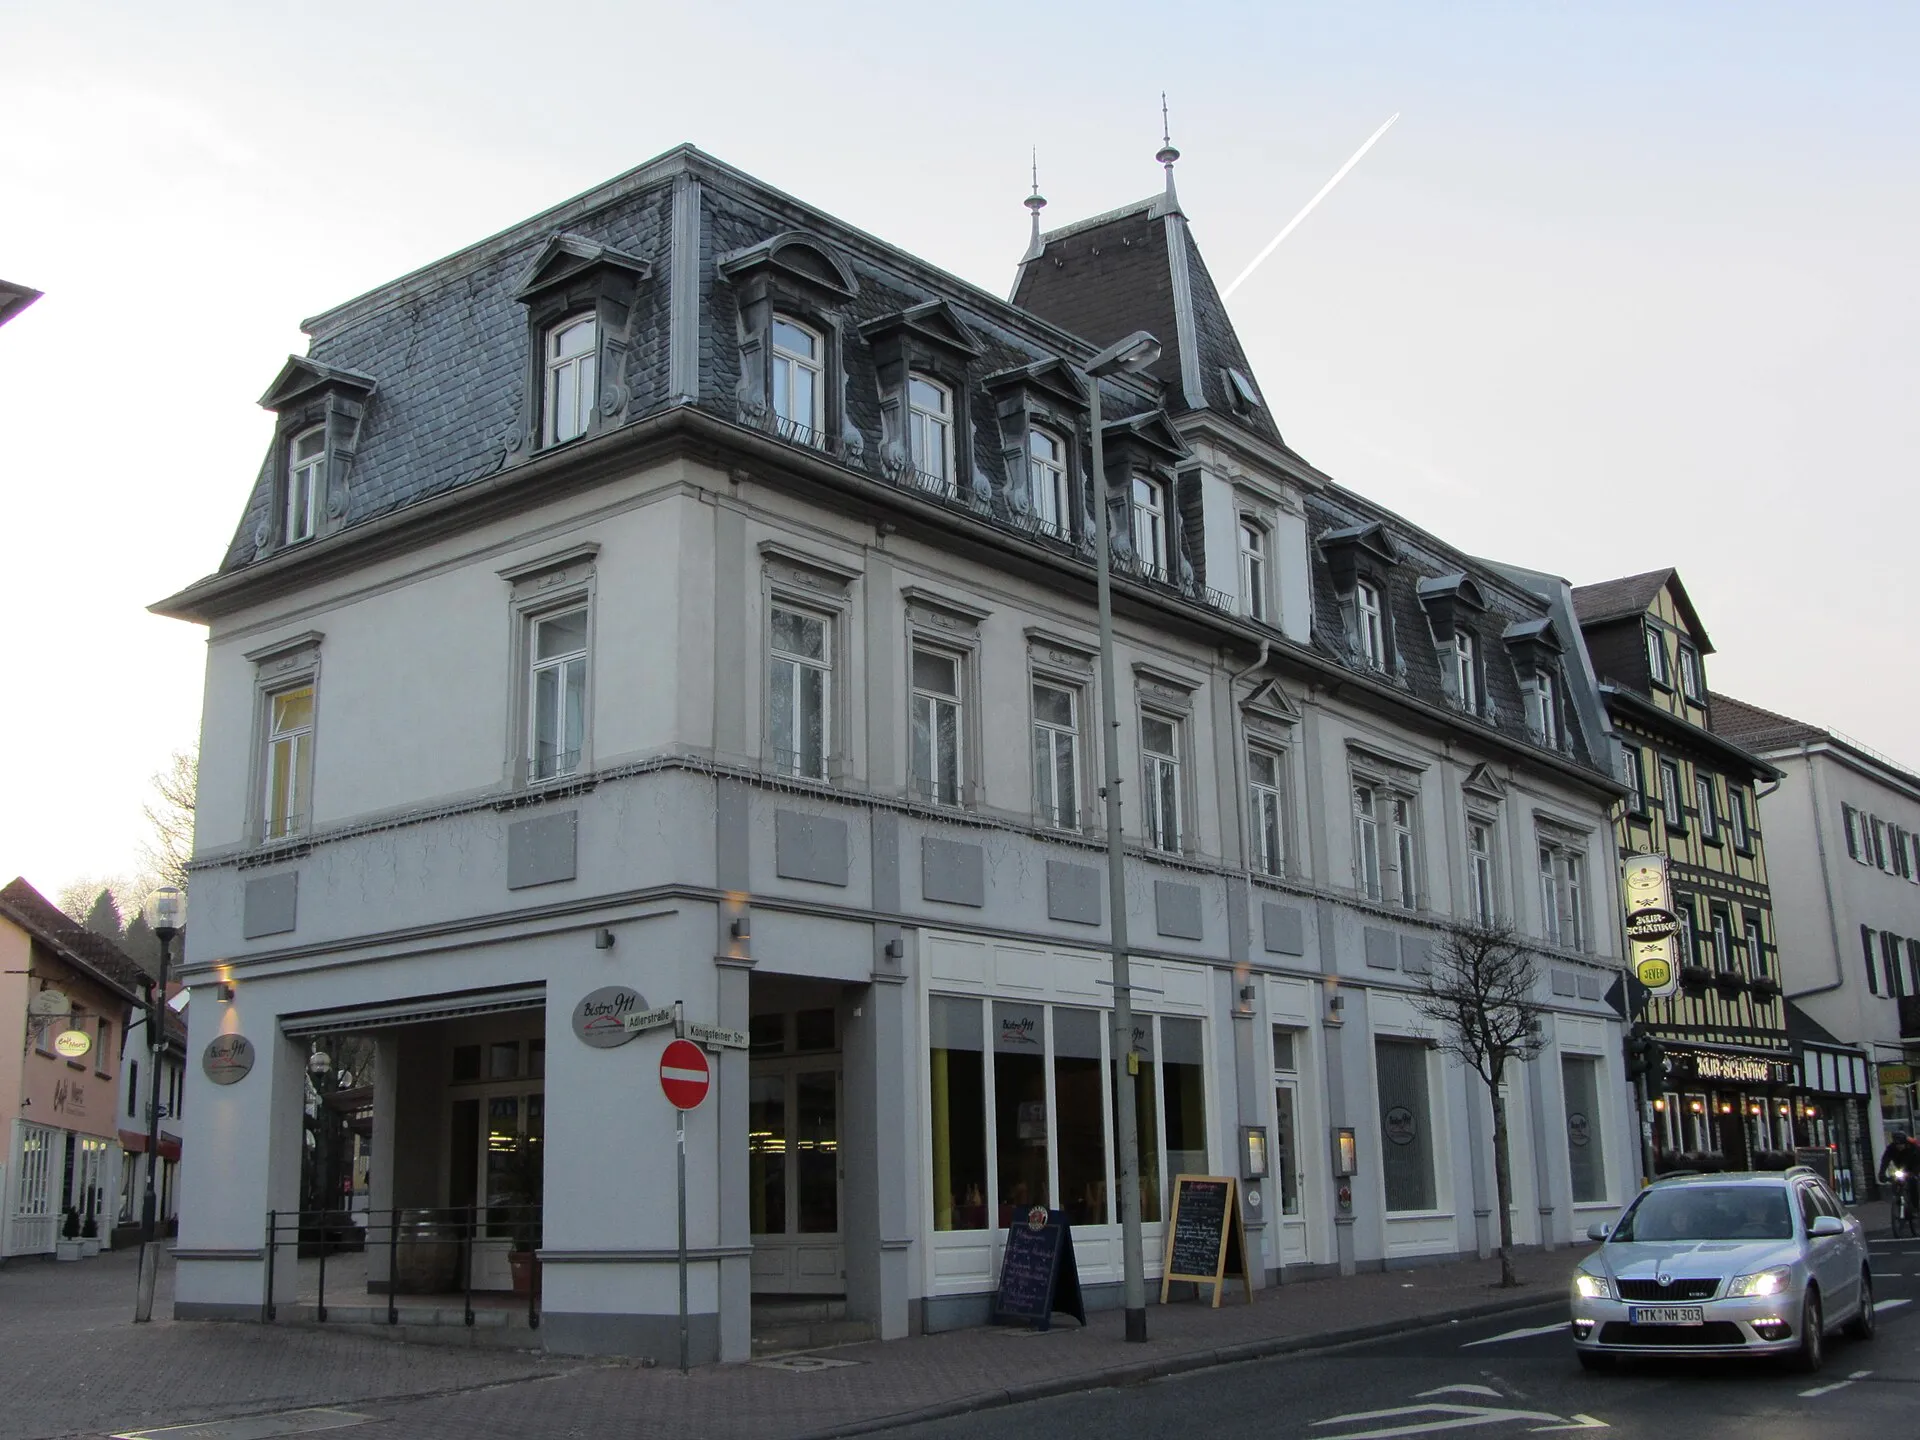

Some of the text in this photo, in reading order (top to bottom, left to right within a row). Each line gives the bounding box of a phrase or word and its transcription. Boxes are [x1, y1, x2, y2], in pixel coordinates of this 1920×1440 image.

[1644, 968, 1665, 980] JEVER
[584, 993, 636, 1017] Bistro 911
[629, 1009, 670, 1028] Adlerstraße
[1021, 1017, 1034, 1031] 911
[690, 1024, 745, 1044] Königsteiner Str.
[1637, 1309, 1701, 1321] MTK NH 303
